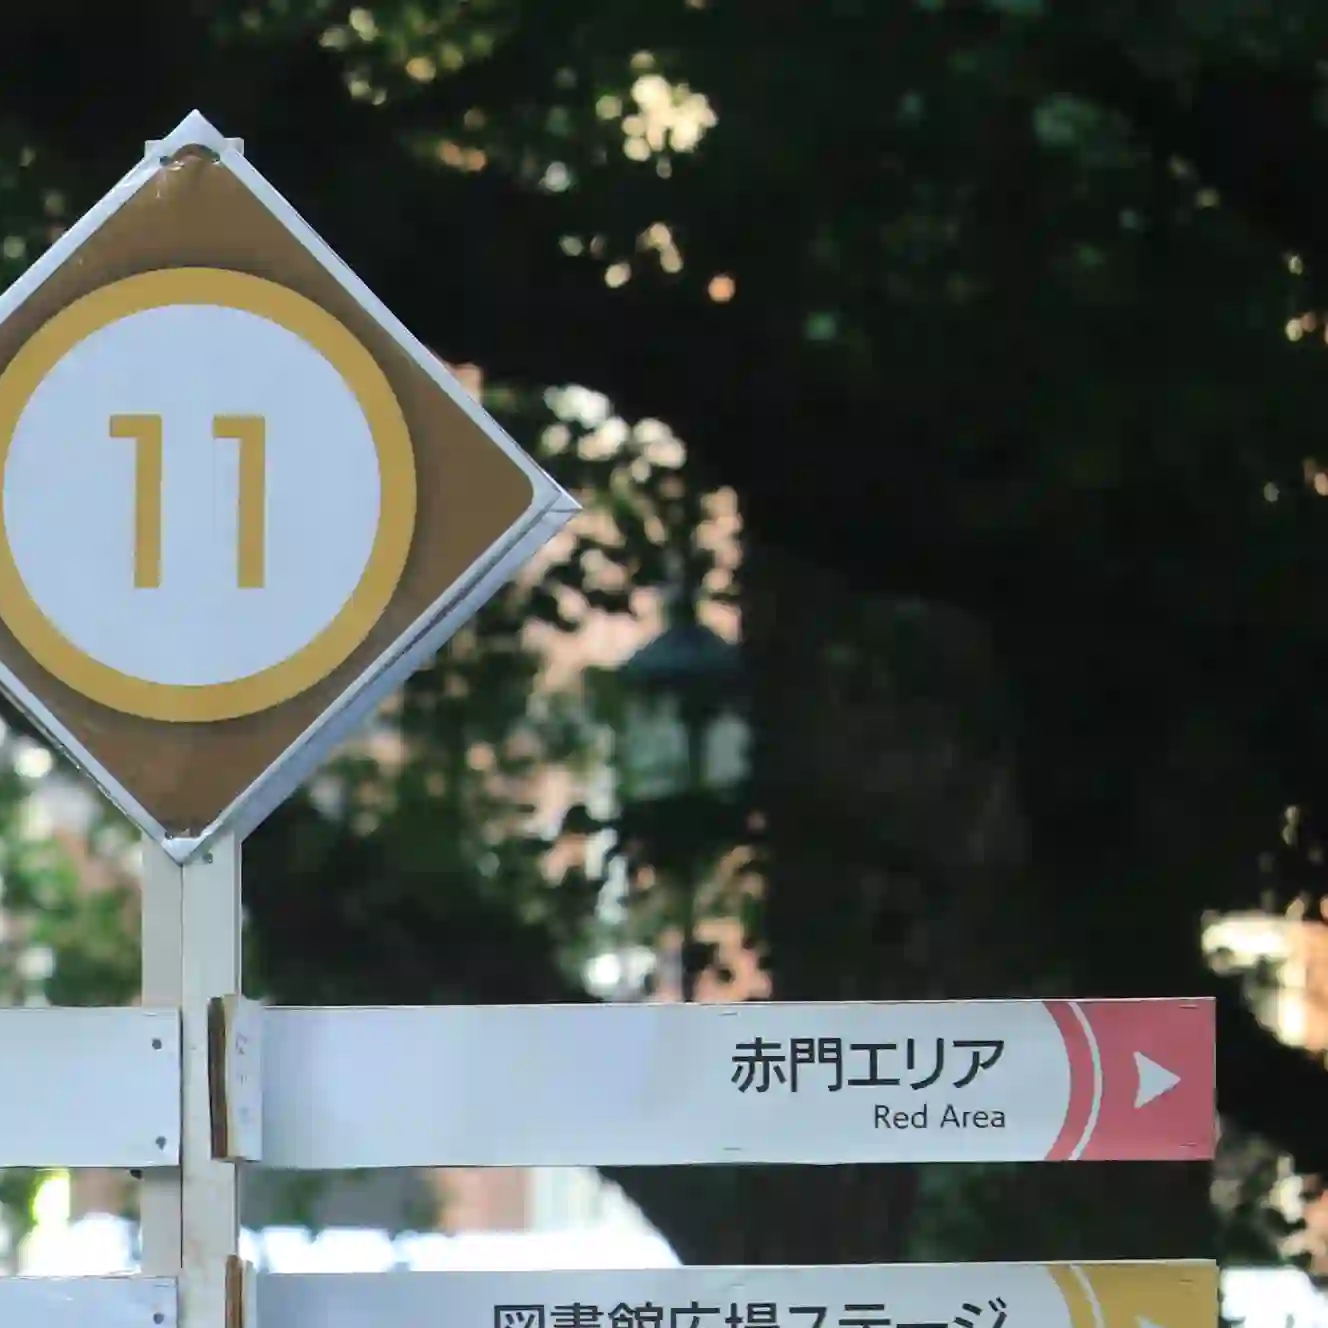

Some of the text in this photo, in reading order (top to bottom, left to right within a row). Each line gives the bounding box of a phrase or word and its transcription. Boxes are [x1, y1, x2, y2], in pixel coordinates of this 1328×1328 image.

[108, 413, 267, 590] 11
[730, 1036, 1005, 1093] 赤門エリア
[875, 1103, 1006, 1130] Red Area
